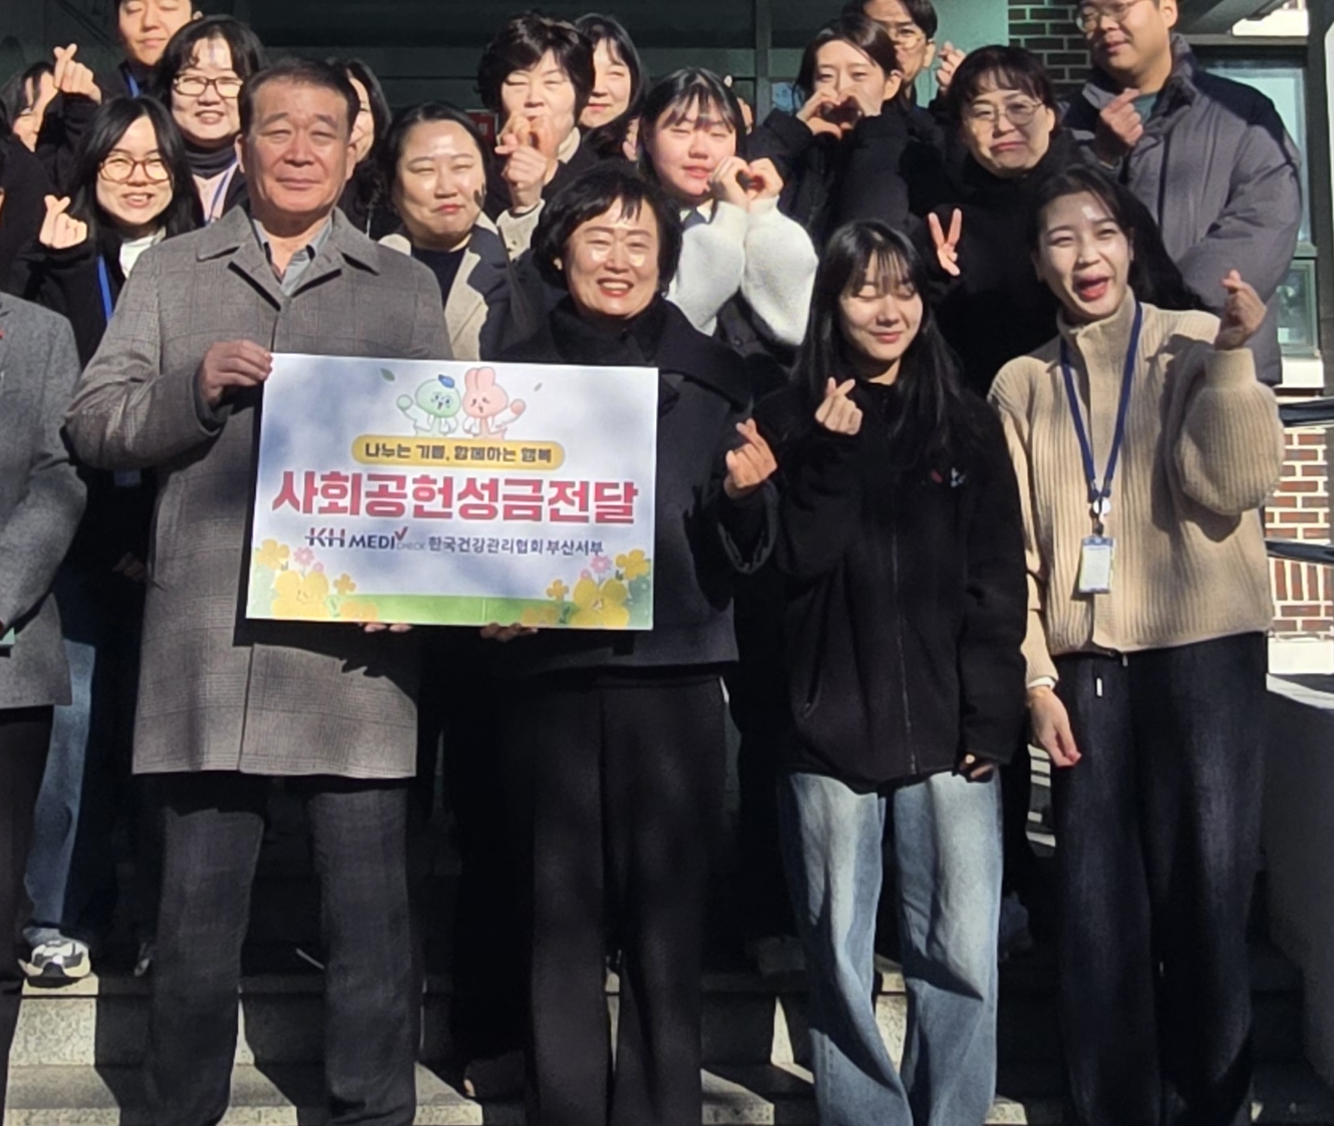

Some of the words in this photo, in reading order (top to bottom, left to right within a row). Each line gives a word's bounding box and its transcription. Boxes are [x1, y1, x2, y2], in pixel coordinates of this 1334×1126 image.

[364, 442, 412, 460] 나누는
[453, 446, 517, 463] 함께하는
[520, 449, 554, 464] 행복
[271, 470, 639, 525] 사회공헌성금전달
[428, 535, 544, 555] 한국건강관리협회
[546, 538, 605, 556] 부산서부
